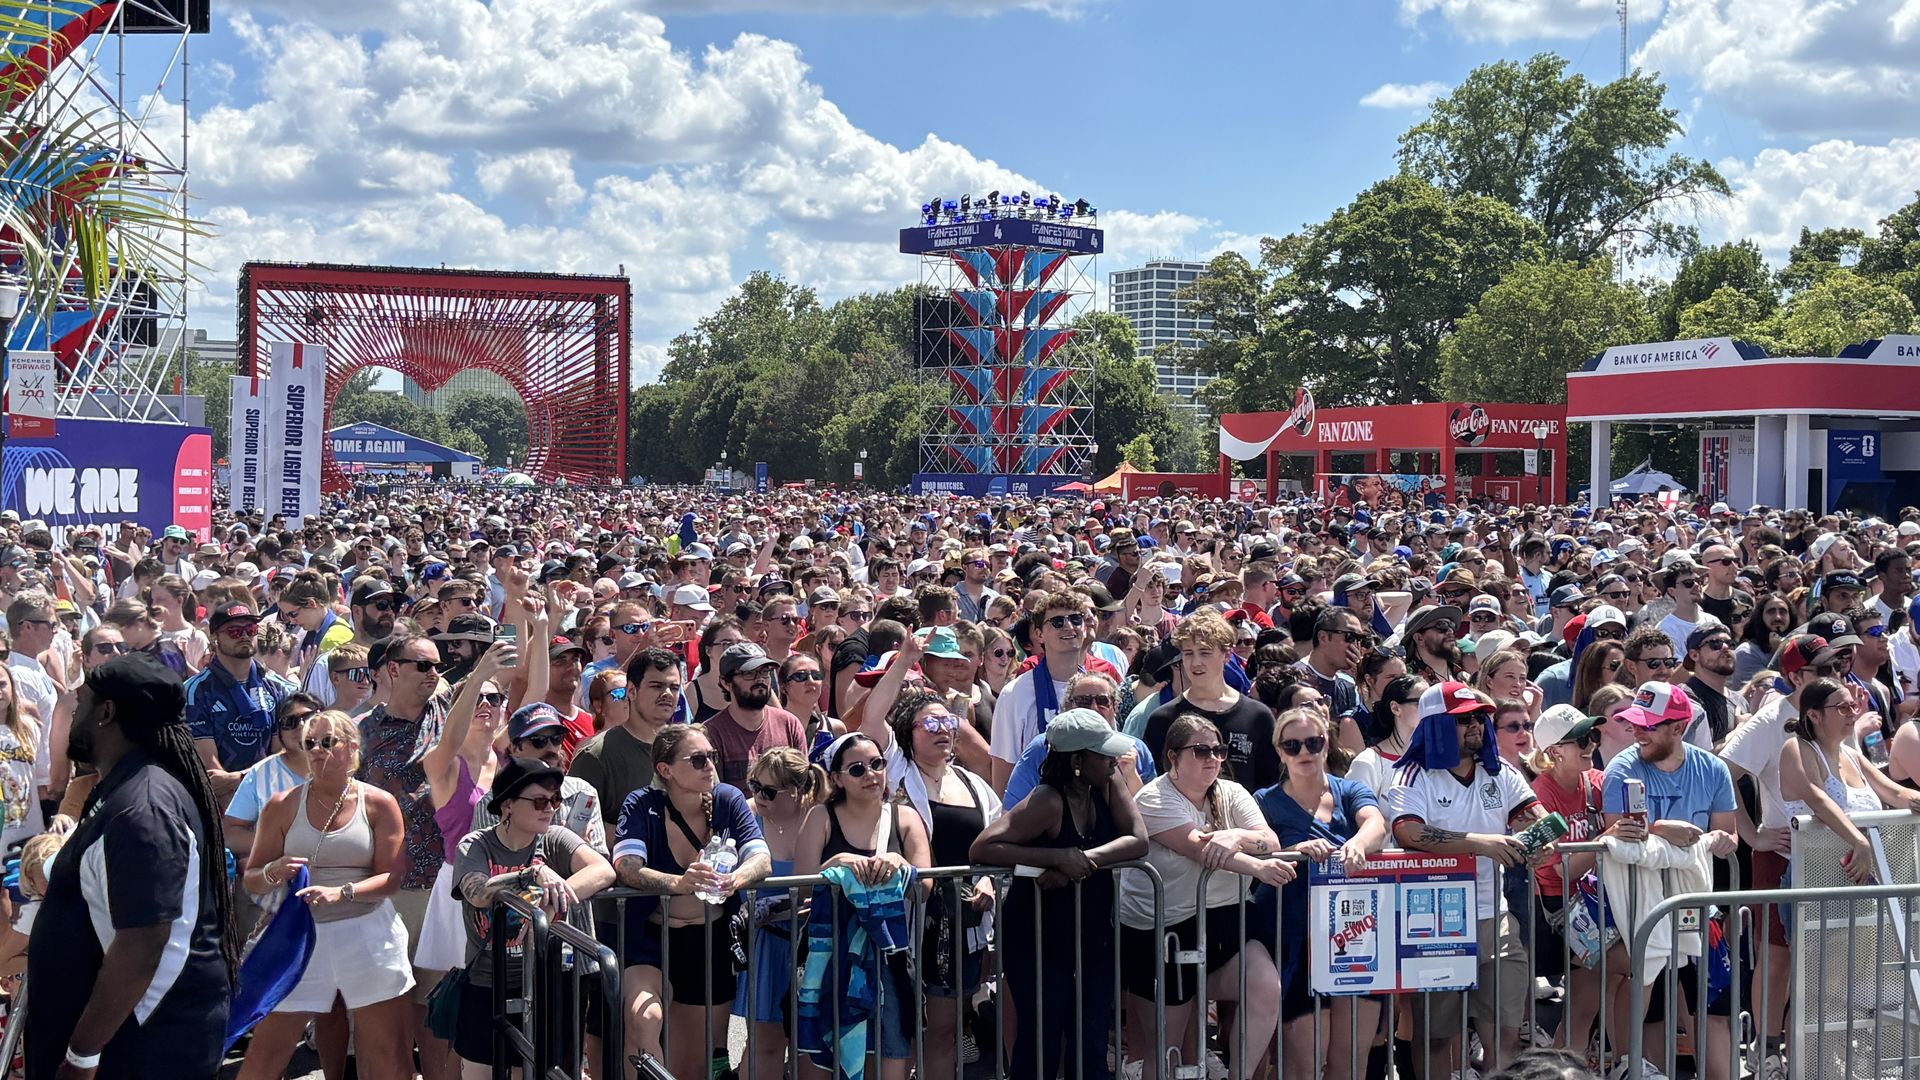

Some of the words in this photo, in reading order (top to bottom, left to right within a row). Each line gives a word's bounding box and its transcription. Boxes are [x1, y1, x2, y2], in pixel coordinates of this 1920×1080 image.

[934, 238, 957, 247] KANSAS
[958, 236, 972, 245] CITY
[1038, 236, 1061, 246] KANSAS
[1062, 239, 1076, 247] CITY
[11, 363, 51, 371] FORWARD
[1614, 353, 1639, 366] BANK
[1640, 353, 1652, 364] OF
[1654, 349, 1698, 363] AMERICA
[284, 384, 305, 447] SUPERIOR
[244, 408, 260, 455] SUPERIOR
[1318, 422, 1340, 442] FAN
[1341, 421, 1373, 442] ZONE
[1490, 419, 1519, 433] FAN
[364, 440, 406, 454] AGAIN
[243, 457, 257, 484] LIGHT
[282, 450, 302, 485] LIGHT
[25, 467, 76, 516] WE
[80, 467, 139, 514] ARE
[921, 481, 936, 490] GOOD
[937, 481, 965, 491] MATCHES.
[281, 487, 300, 519] BEER
[1364, 859, 1420, 870] REDENTIAL
[1421, 858, 1458, 868] BOARD
[1333, 914, 1376, 948] DEMO
